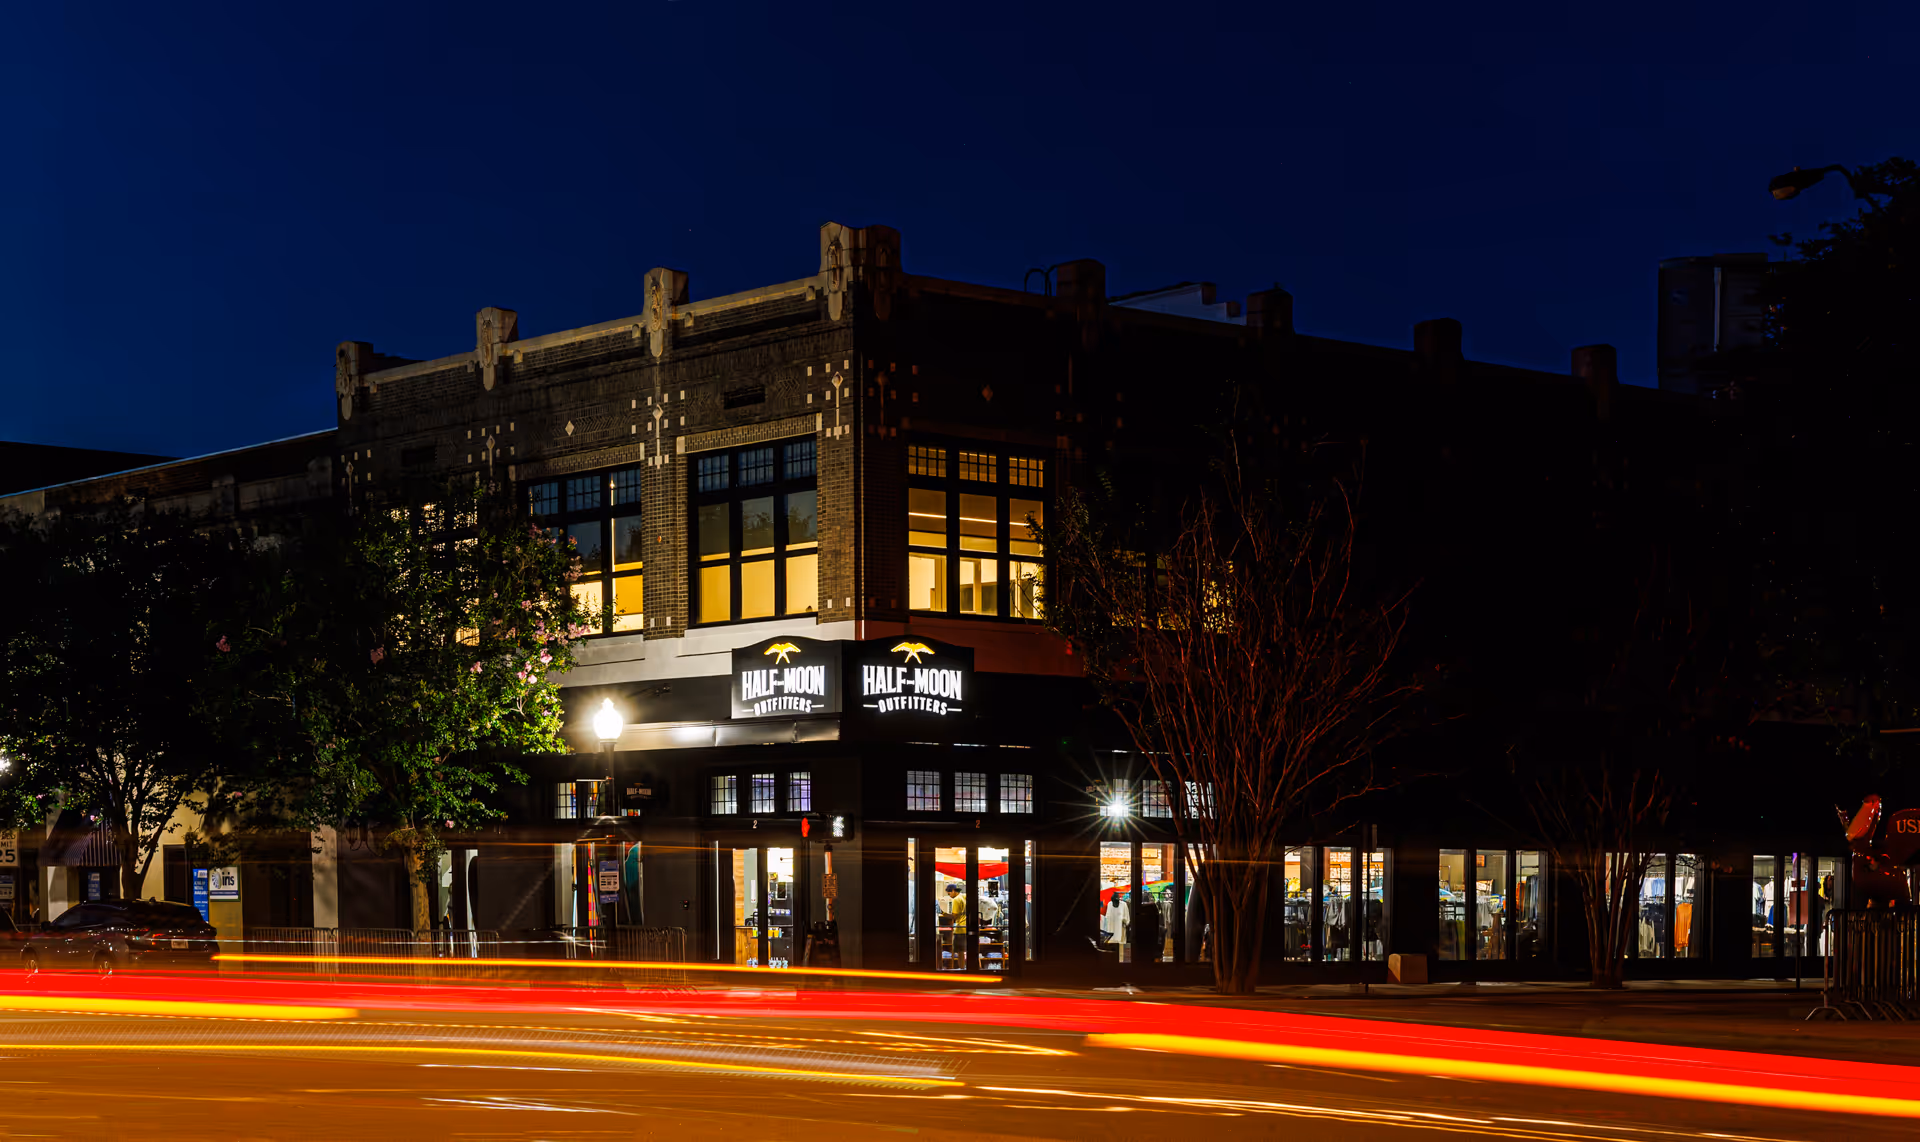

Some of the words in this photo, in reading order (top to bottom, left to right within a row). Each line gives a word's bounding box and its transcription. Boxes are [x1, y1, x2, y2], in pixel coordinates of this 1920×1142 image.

[741, 665, 825, 701] HALF-MOON
[862, 665, 962, 700] HALF-MOON
[753, 696, 812, 716] OUTFITTERS
[878, 696, 948, 715] OUTFITTERS
[752, 819, 758, 829] 2
[975, 819, 981, 829] 2
[0, 849, 15, 863] 5
